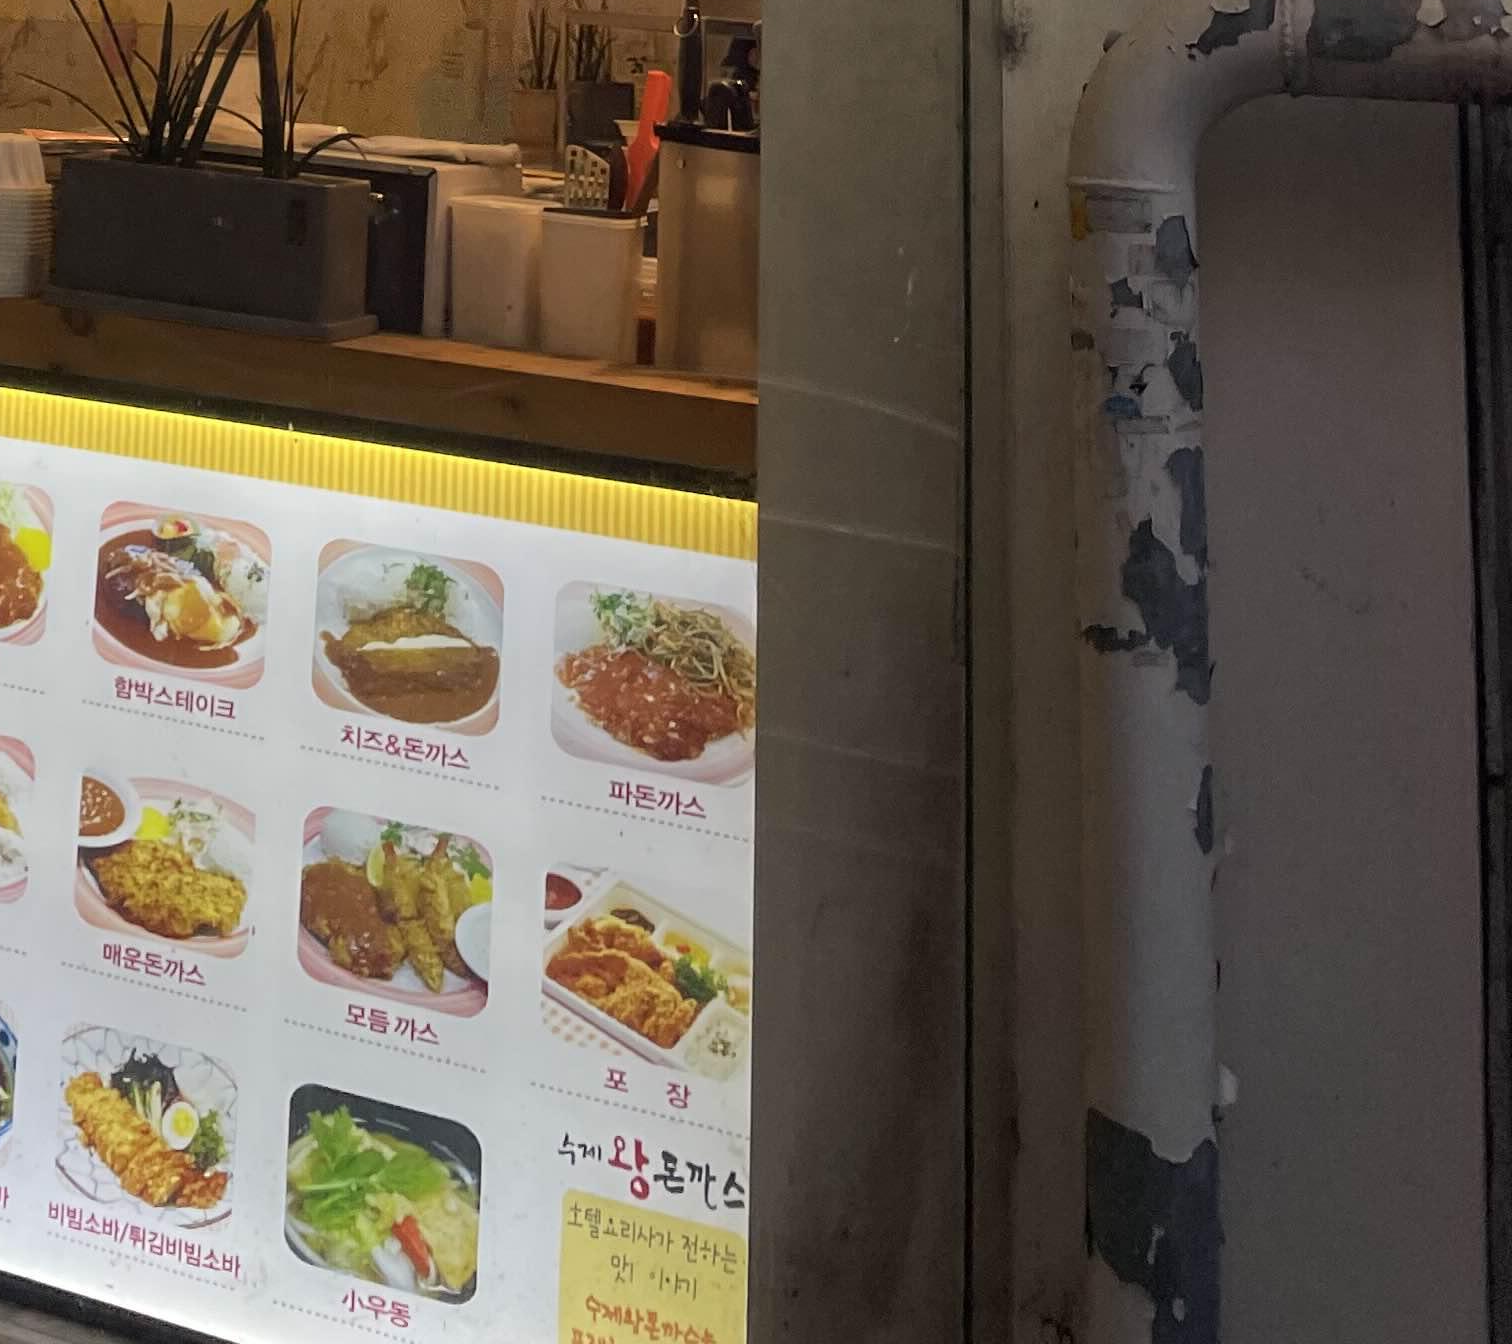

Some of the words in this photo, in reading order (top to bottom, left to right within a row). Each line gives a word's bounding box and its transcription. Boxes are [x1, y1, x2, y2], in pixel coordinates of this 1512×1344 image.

[114, 676, 236, 720] 함박스테이크
[340, 725, 471, 770] 치즈&돈까스
[609, 780, 707, 820] 파돈까스
[103, 943, 207, 986] 매운돈까스
[48, 1201, 241, 1279] 비빔소바/튀김비빔소바
